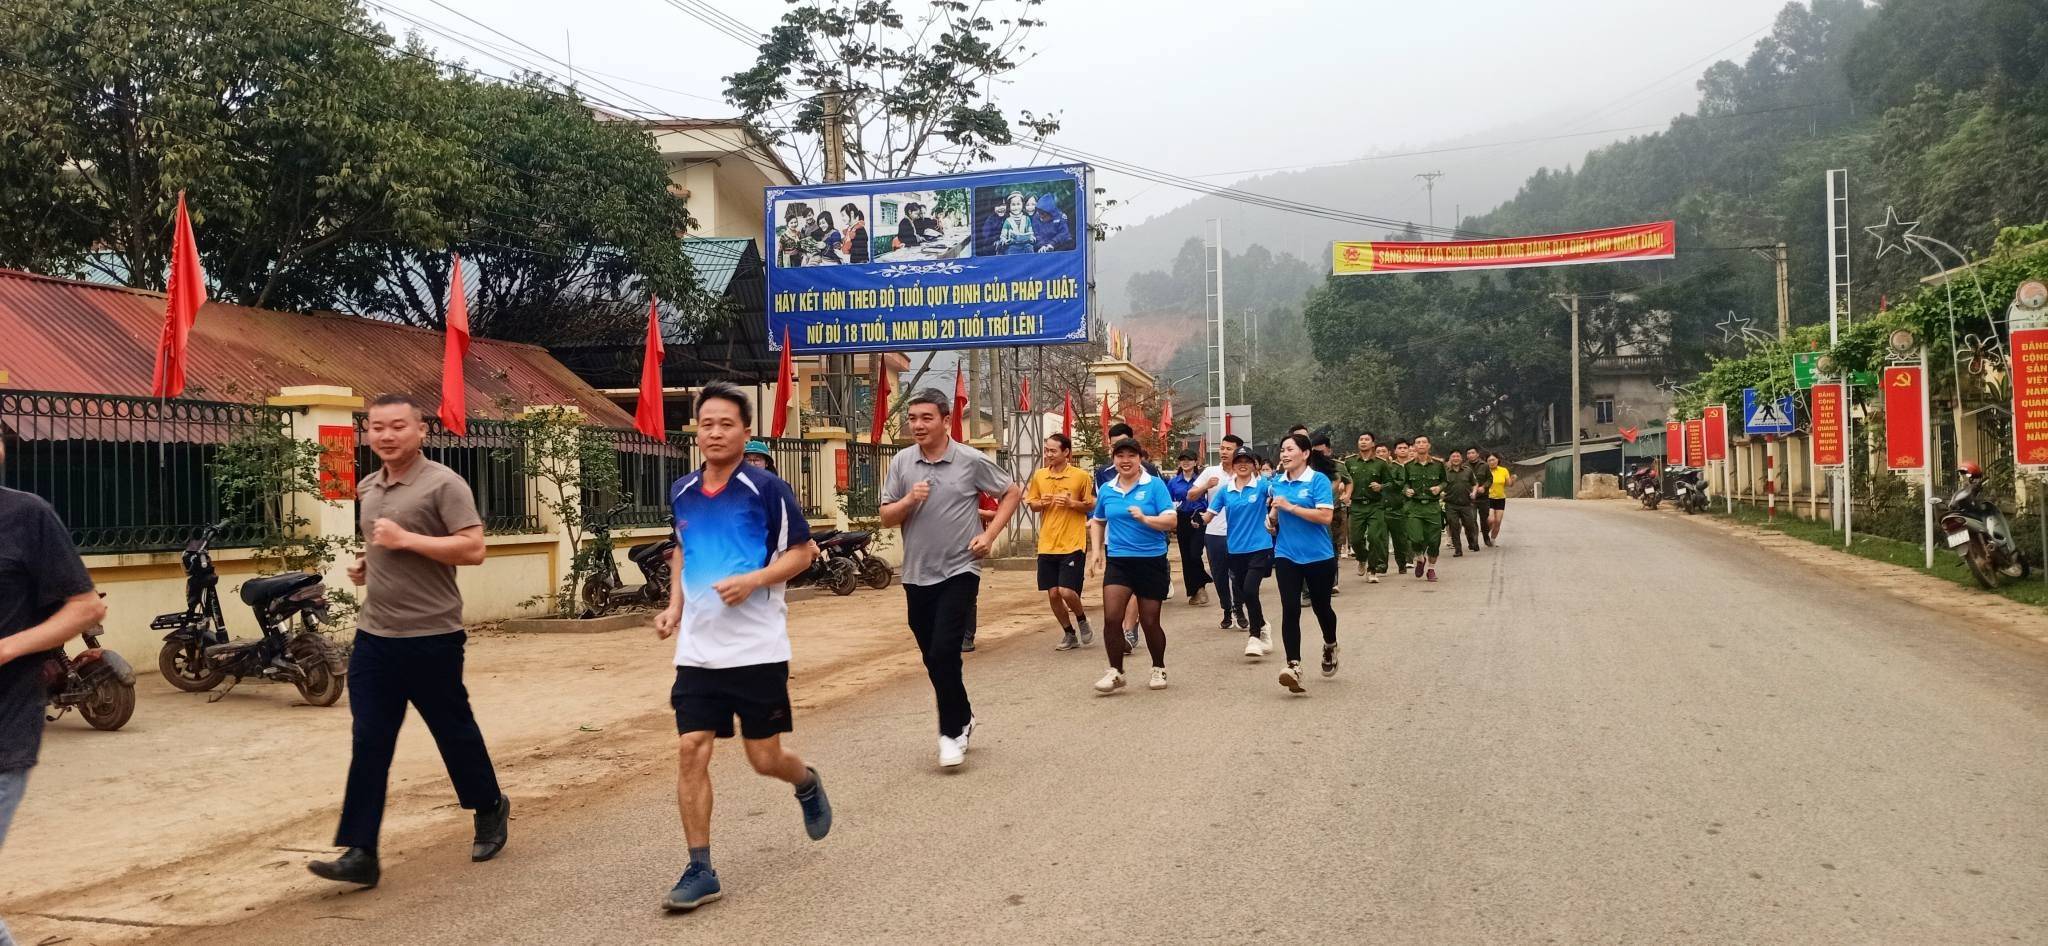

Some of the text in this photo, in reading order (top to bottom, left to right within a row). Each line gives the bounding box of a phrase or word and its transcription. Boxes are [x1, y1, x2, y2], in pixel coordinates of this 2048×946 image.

[1378, 248, 1401, 264] SÁNG
[1404, 246, 1425, 262] SUỐT
[1428, 247, 1444, 264] LỰA
[1446, 246, 1469, 264] CHỌN
[1594, 236, 1611, 252] CHO
[1614, 233, 1639, 250] NHÂN
[1642, 230, 1664, 248] DÂN!
[775, 274, 1078, 313] HÃY KẾT HÔN THEO ĐỘ TUỔI QUY ĐỊNH CỦA PHÁP LUẬT:
[806, 321, 824, 345] NỮ
[826, 318, 841, 344] ĐỦ
[844, 324, 857, 343] 18
[861, 314, 889, 344] TUỔI,
[892, 320, 919, 341] NAM
[922, 313, 938, 340] ĐỦ
[941, 319, 955, 339] 20
[958, 310, 983, 338] TUỔI
[987, 310, 1010, 336] TRỞ
[1013, 311, 1035, 336] LÊN
[2026, 363, 2047, 373] SẢN
[2027, 375, 2048, 385] VIỆT
[2026, 388, 2048, 396] NAM
[2022, 399, 2048, 408] QUAN
[2024, 420, 2048, 430] MUÔ
